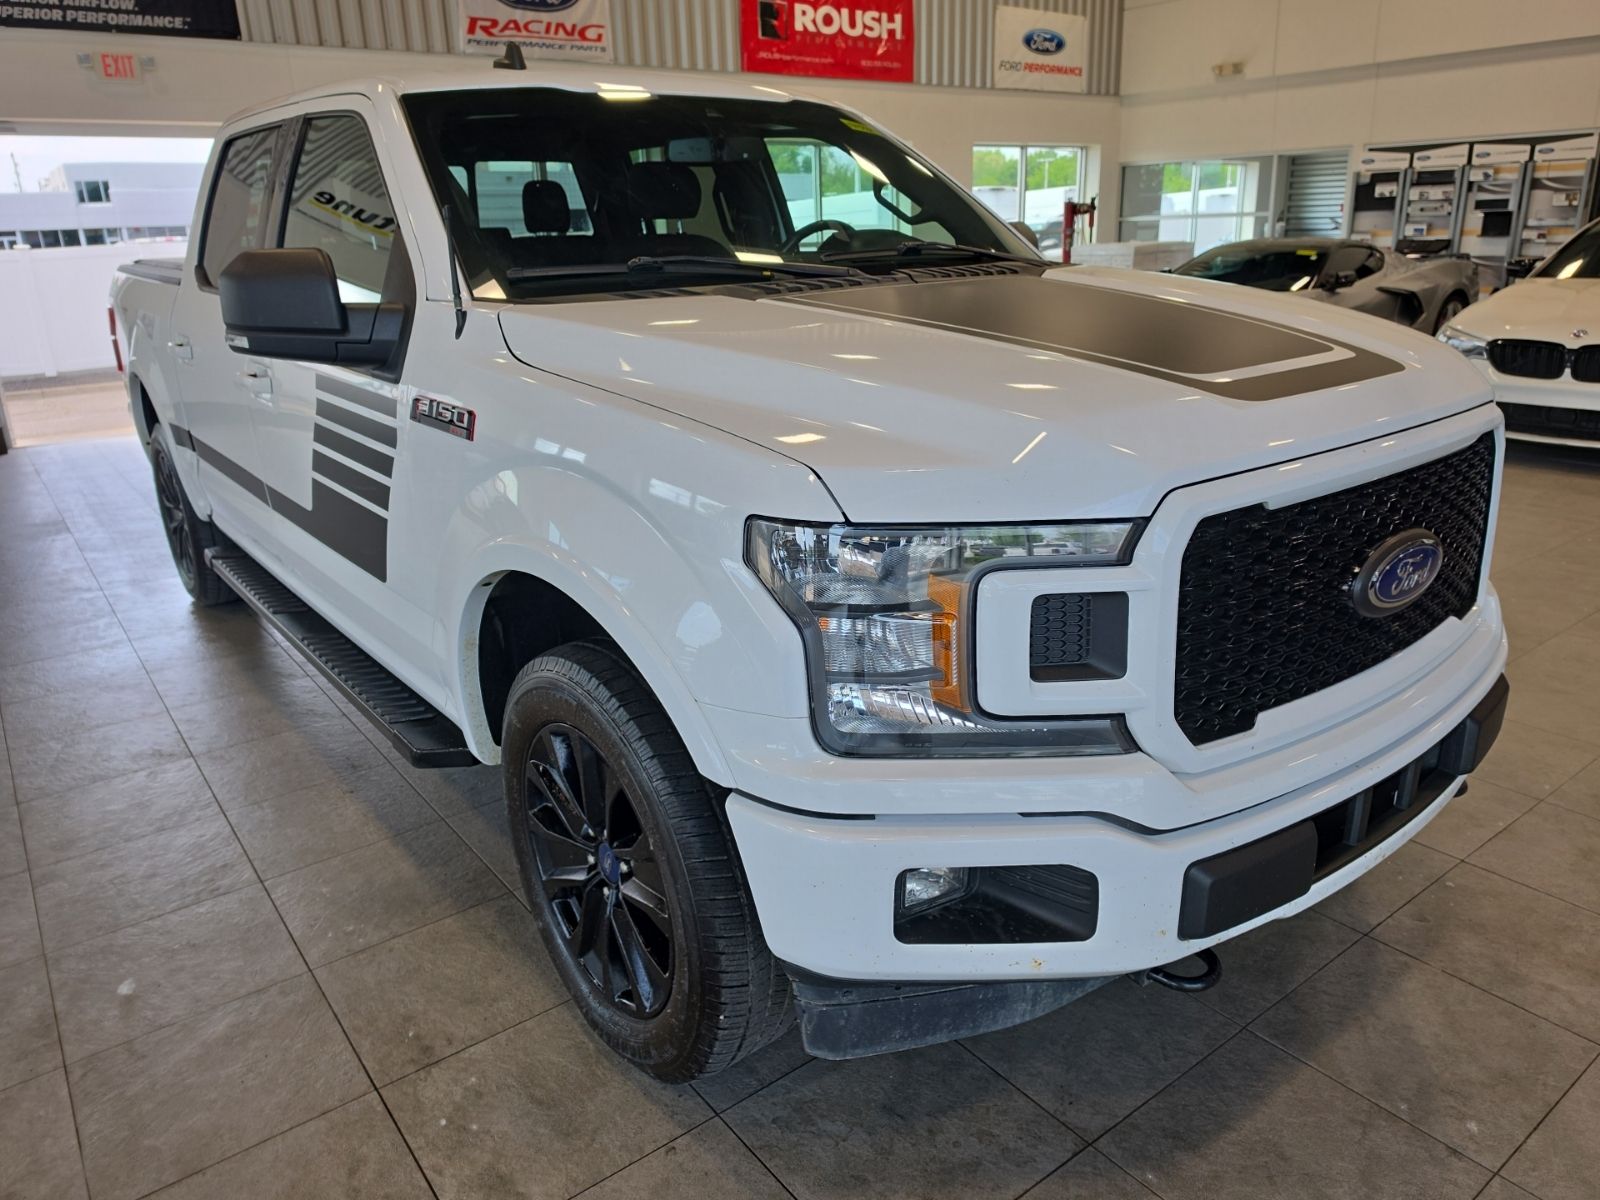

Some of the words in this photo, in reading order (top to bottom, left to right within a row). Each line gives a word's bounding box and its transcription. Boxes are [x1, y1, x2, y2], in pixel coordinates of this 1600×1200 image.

[0, 5, 63, 21] PERIOR
[794, 3, 903, 40] ROUSH
[466, 16, 606, 43] RACING
[101, 53, 136, 79] EXIT
[1023, 61, 1083, 77] PERFORMANCE
[1391, 553, 1433, 596] Ford
